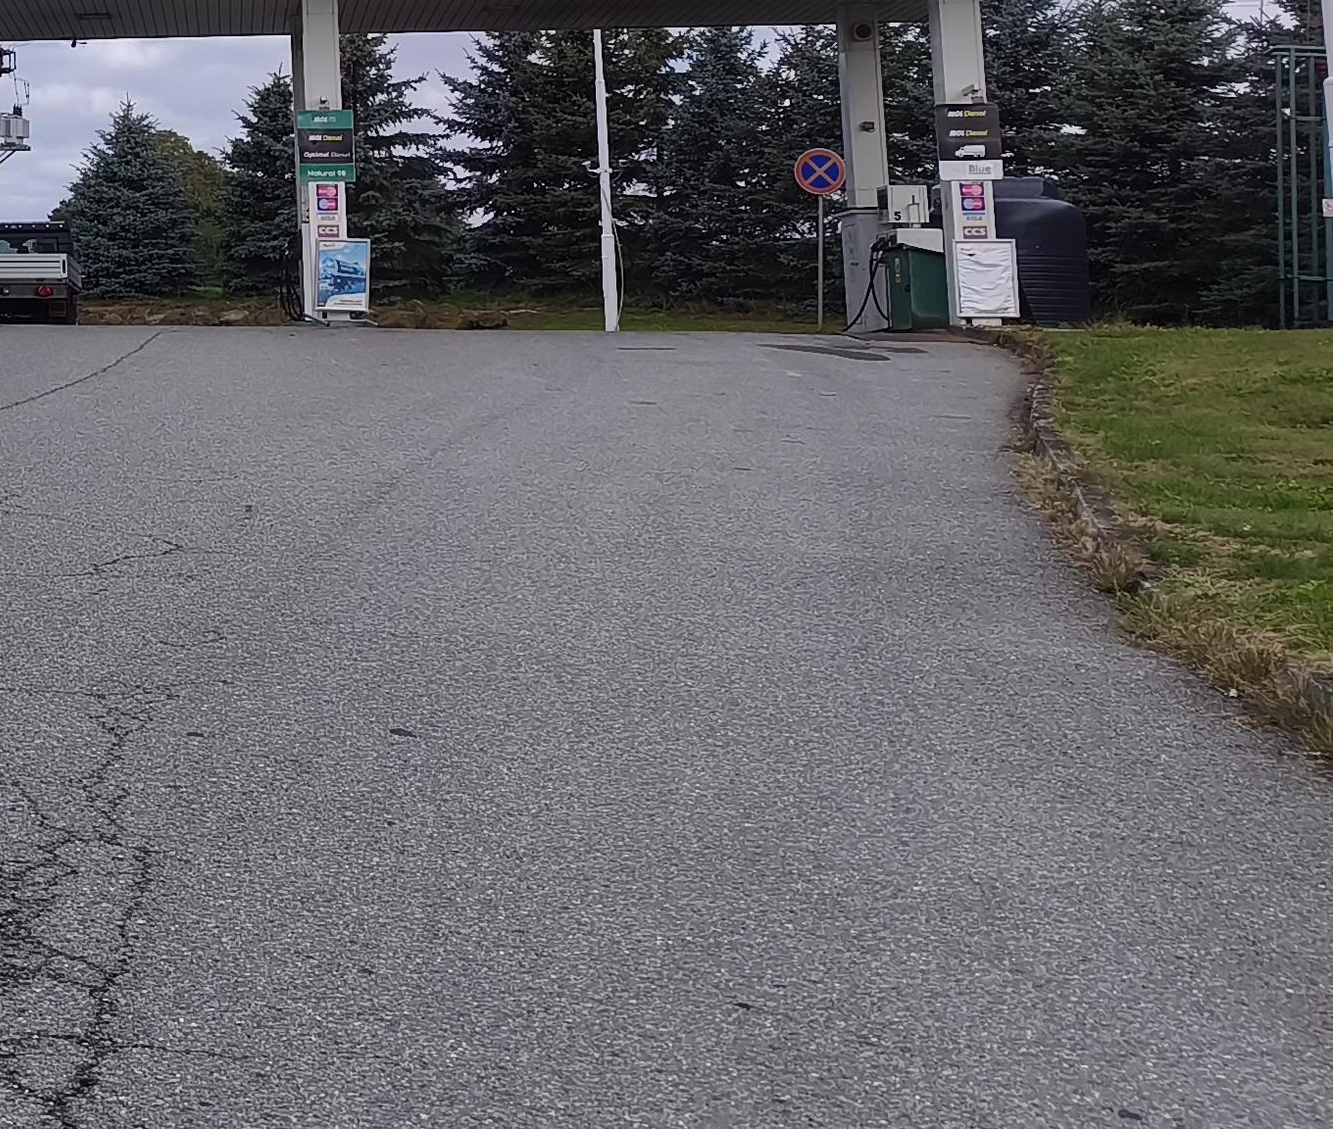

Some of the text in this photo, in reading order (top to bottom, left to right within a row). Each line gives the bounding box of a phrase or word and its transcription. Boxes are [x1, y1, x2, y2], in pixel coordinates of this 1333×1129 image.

[303, 151, 330, 159] Optimal
[307, 169, 336, 177] Natural
[893, 211, 902, 221] 5
[963, 227, 986, 236] CCS
